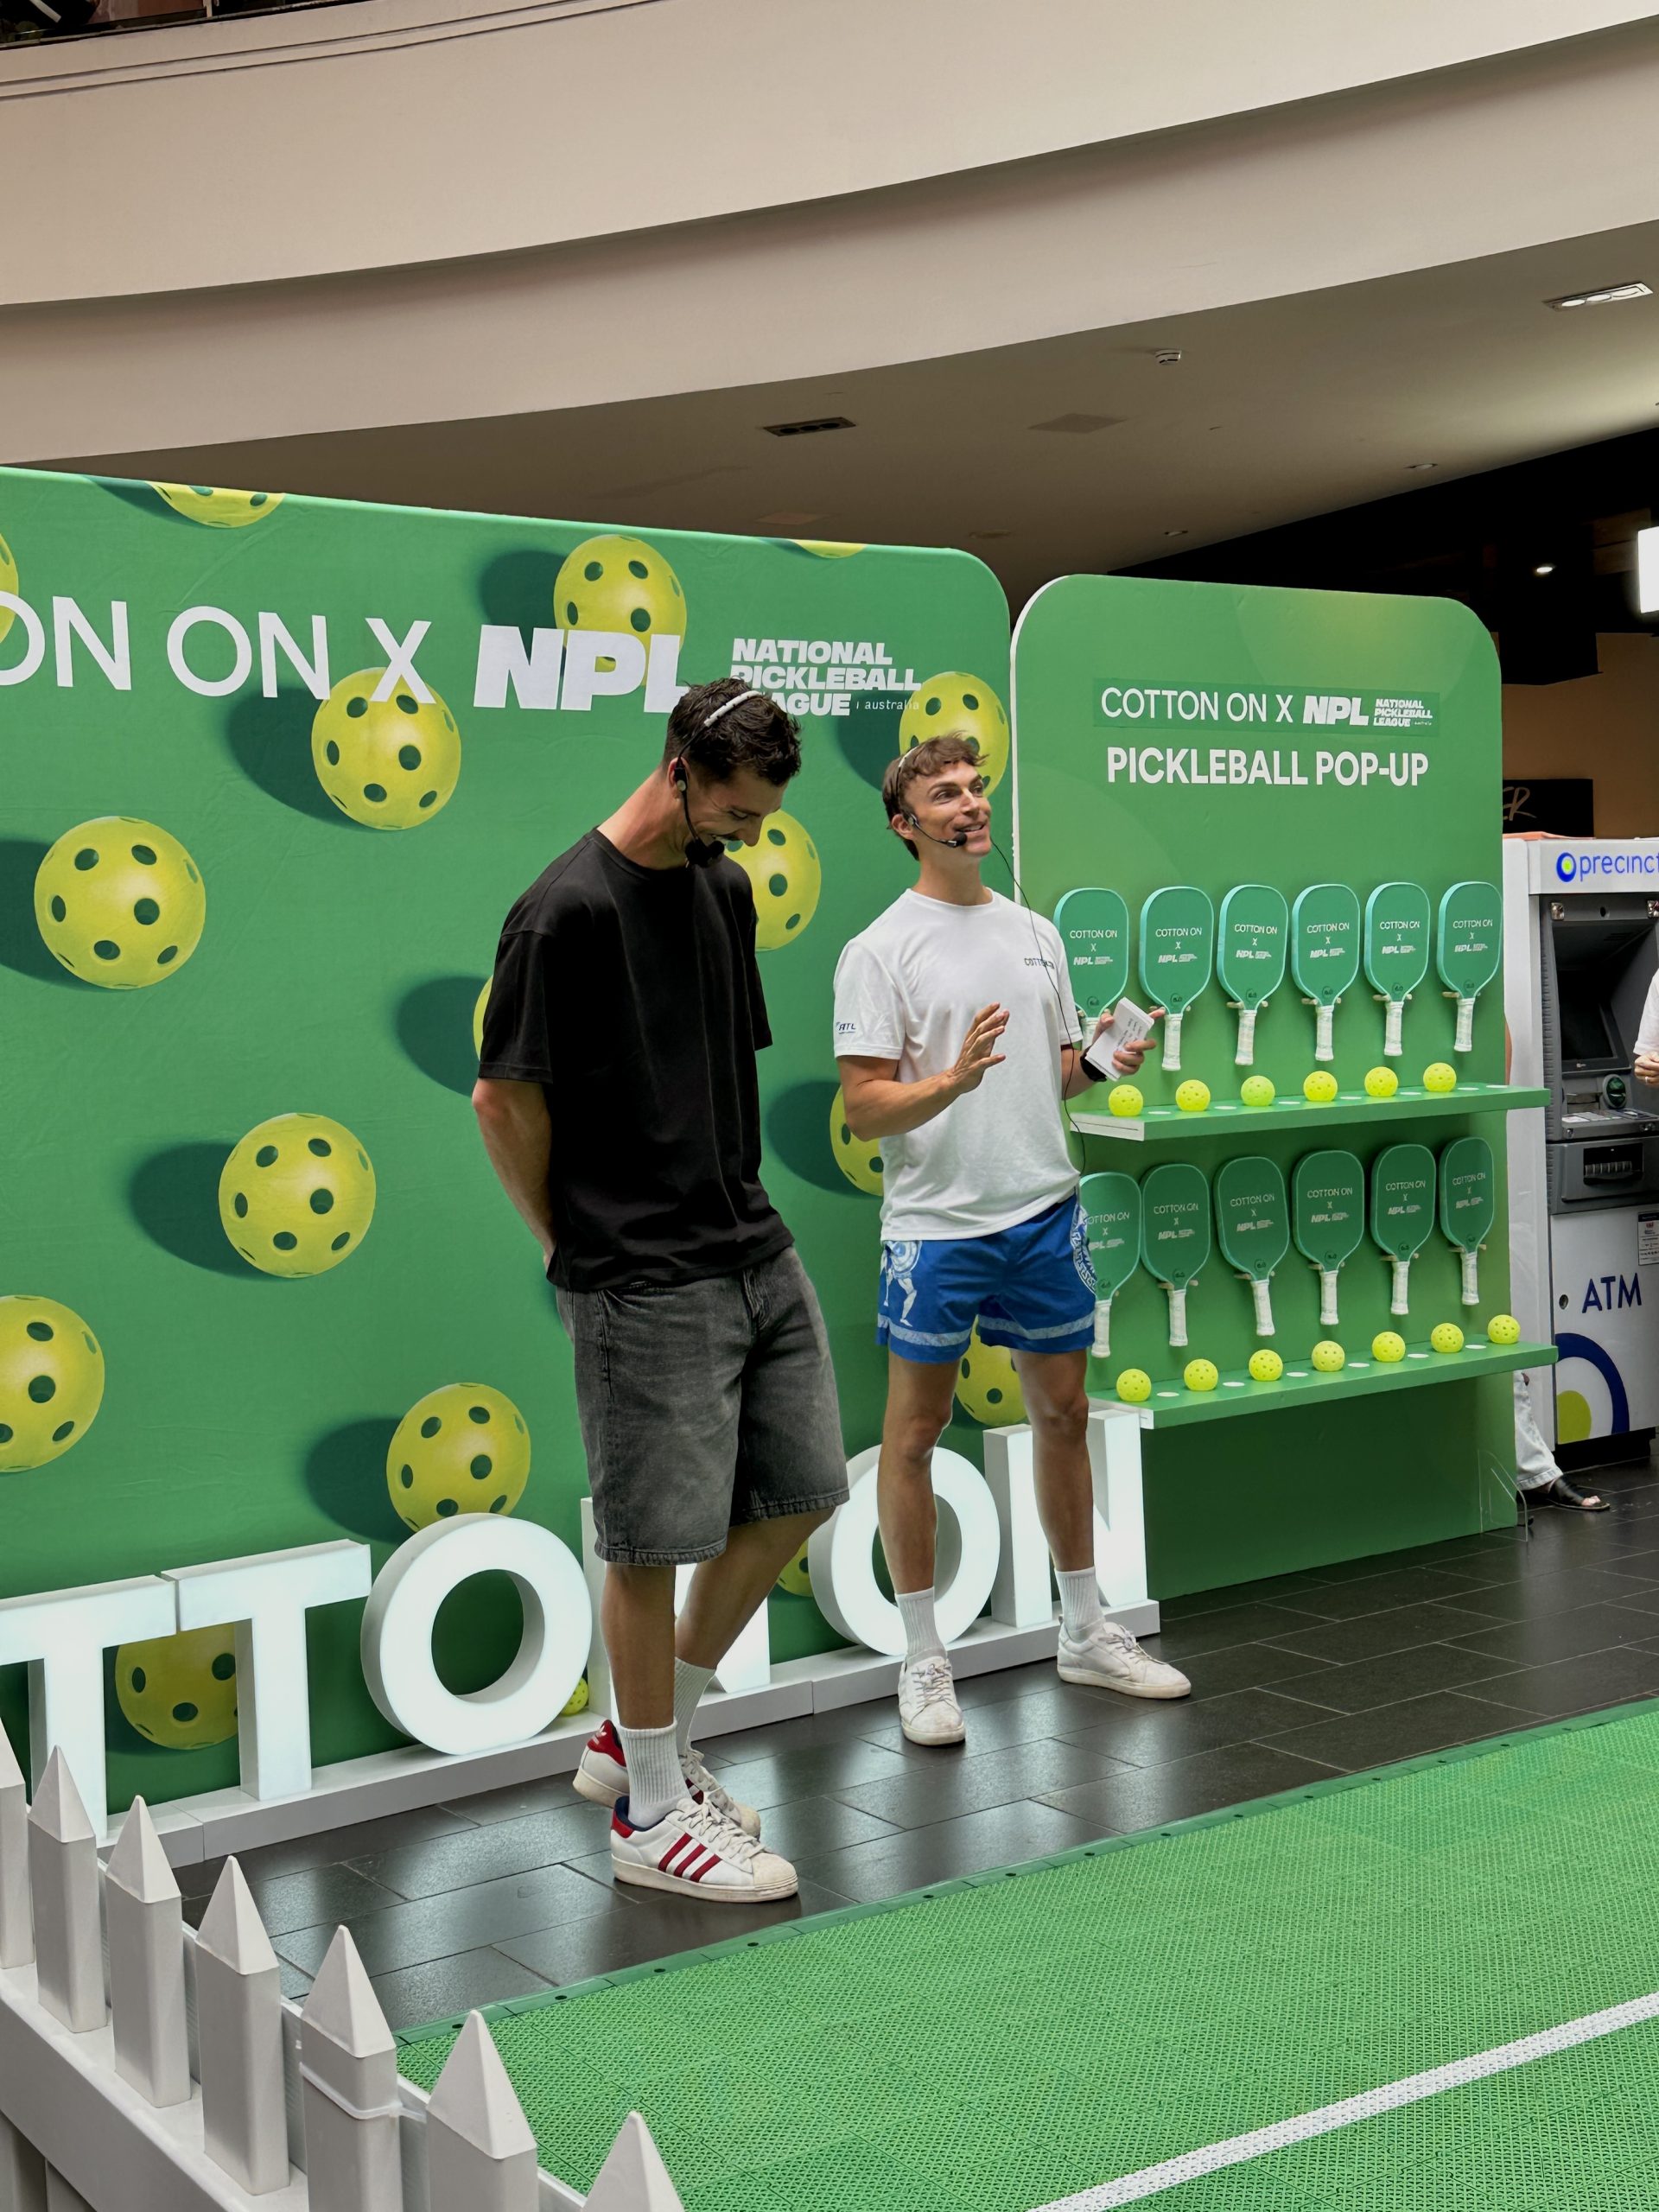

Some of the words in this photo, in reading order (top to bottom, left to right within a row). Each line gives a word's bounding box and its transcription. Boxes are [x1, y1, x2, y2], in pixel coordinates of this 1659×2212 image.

[167, 606, 330, 700] ON
[365, 618, 436, 703] X
[474, 625, 690, 713] NPL
[732, 638, 893, 665] NATIONAL
[730, 664, 921, 691] PICKLEBALL
[764, 692, 852, 716] AGUE
[1101, 687, 1219, 721] COTTON
[1226, 692, 1267, 722] ON
[1275, 694, 1294, 723] X
[1302, 696, 1369, 726] NPL
[1376, 698, 1424, 709] NATIONAL
[1373, 717, 1411, 727] LEAGUE
[1374, 708, 1433, 719] PICKLEBALL
[1107, 747, 1308, 785] PICKLEBALL
[1316, 751, 1428, 786] POP-UP
[1070, 930, 1103, 938] COTTON
[1105, 930, 1117, 938] ON
[1155, 928, 1188, 938] COTTON
[1190, 928, 1202, 937] ON
[1235, 924, 1265, 933] COTTON
[1266, 925, 1277, 934] ON
[1306, 924, 1338, 933] COTTON
[1090, 944, 1096, 952] X
[1581, 1272, 1643, 1313] ATM
[809, 1408, 1148, 1656] ON
